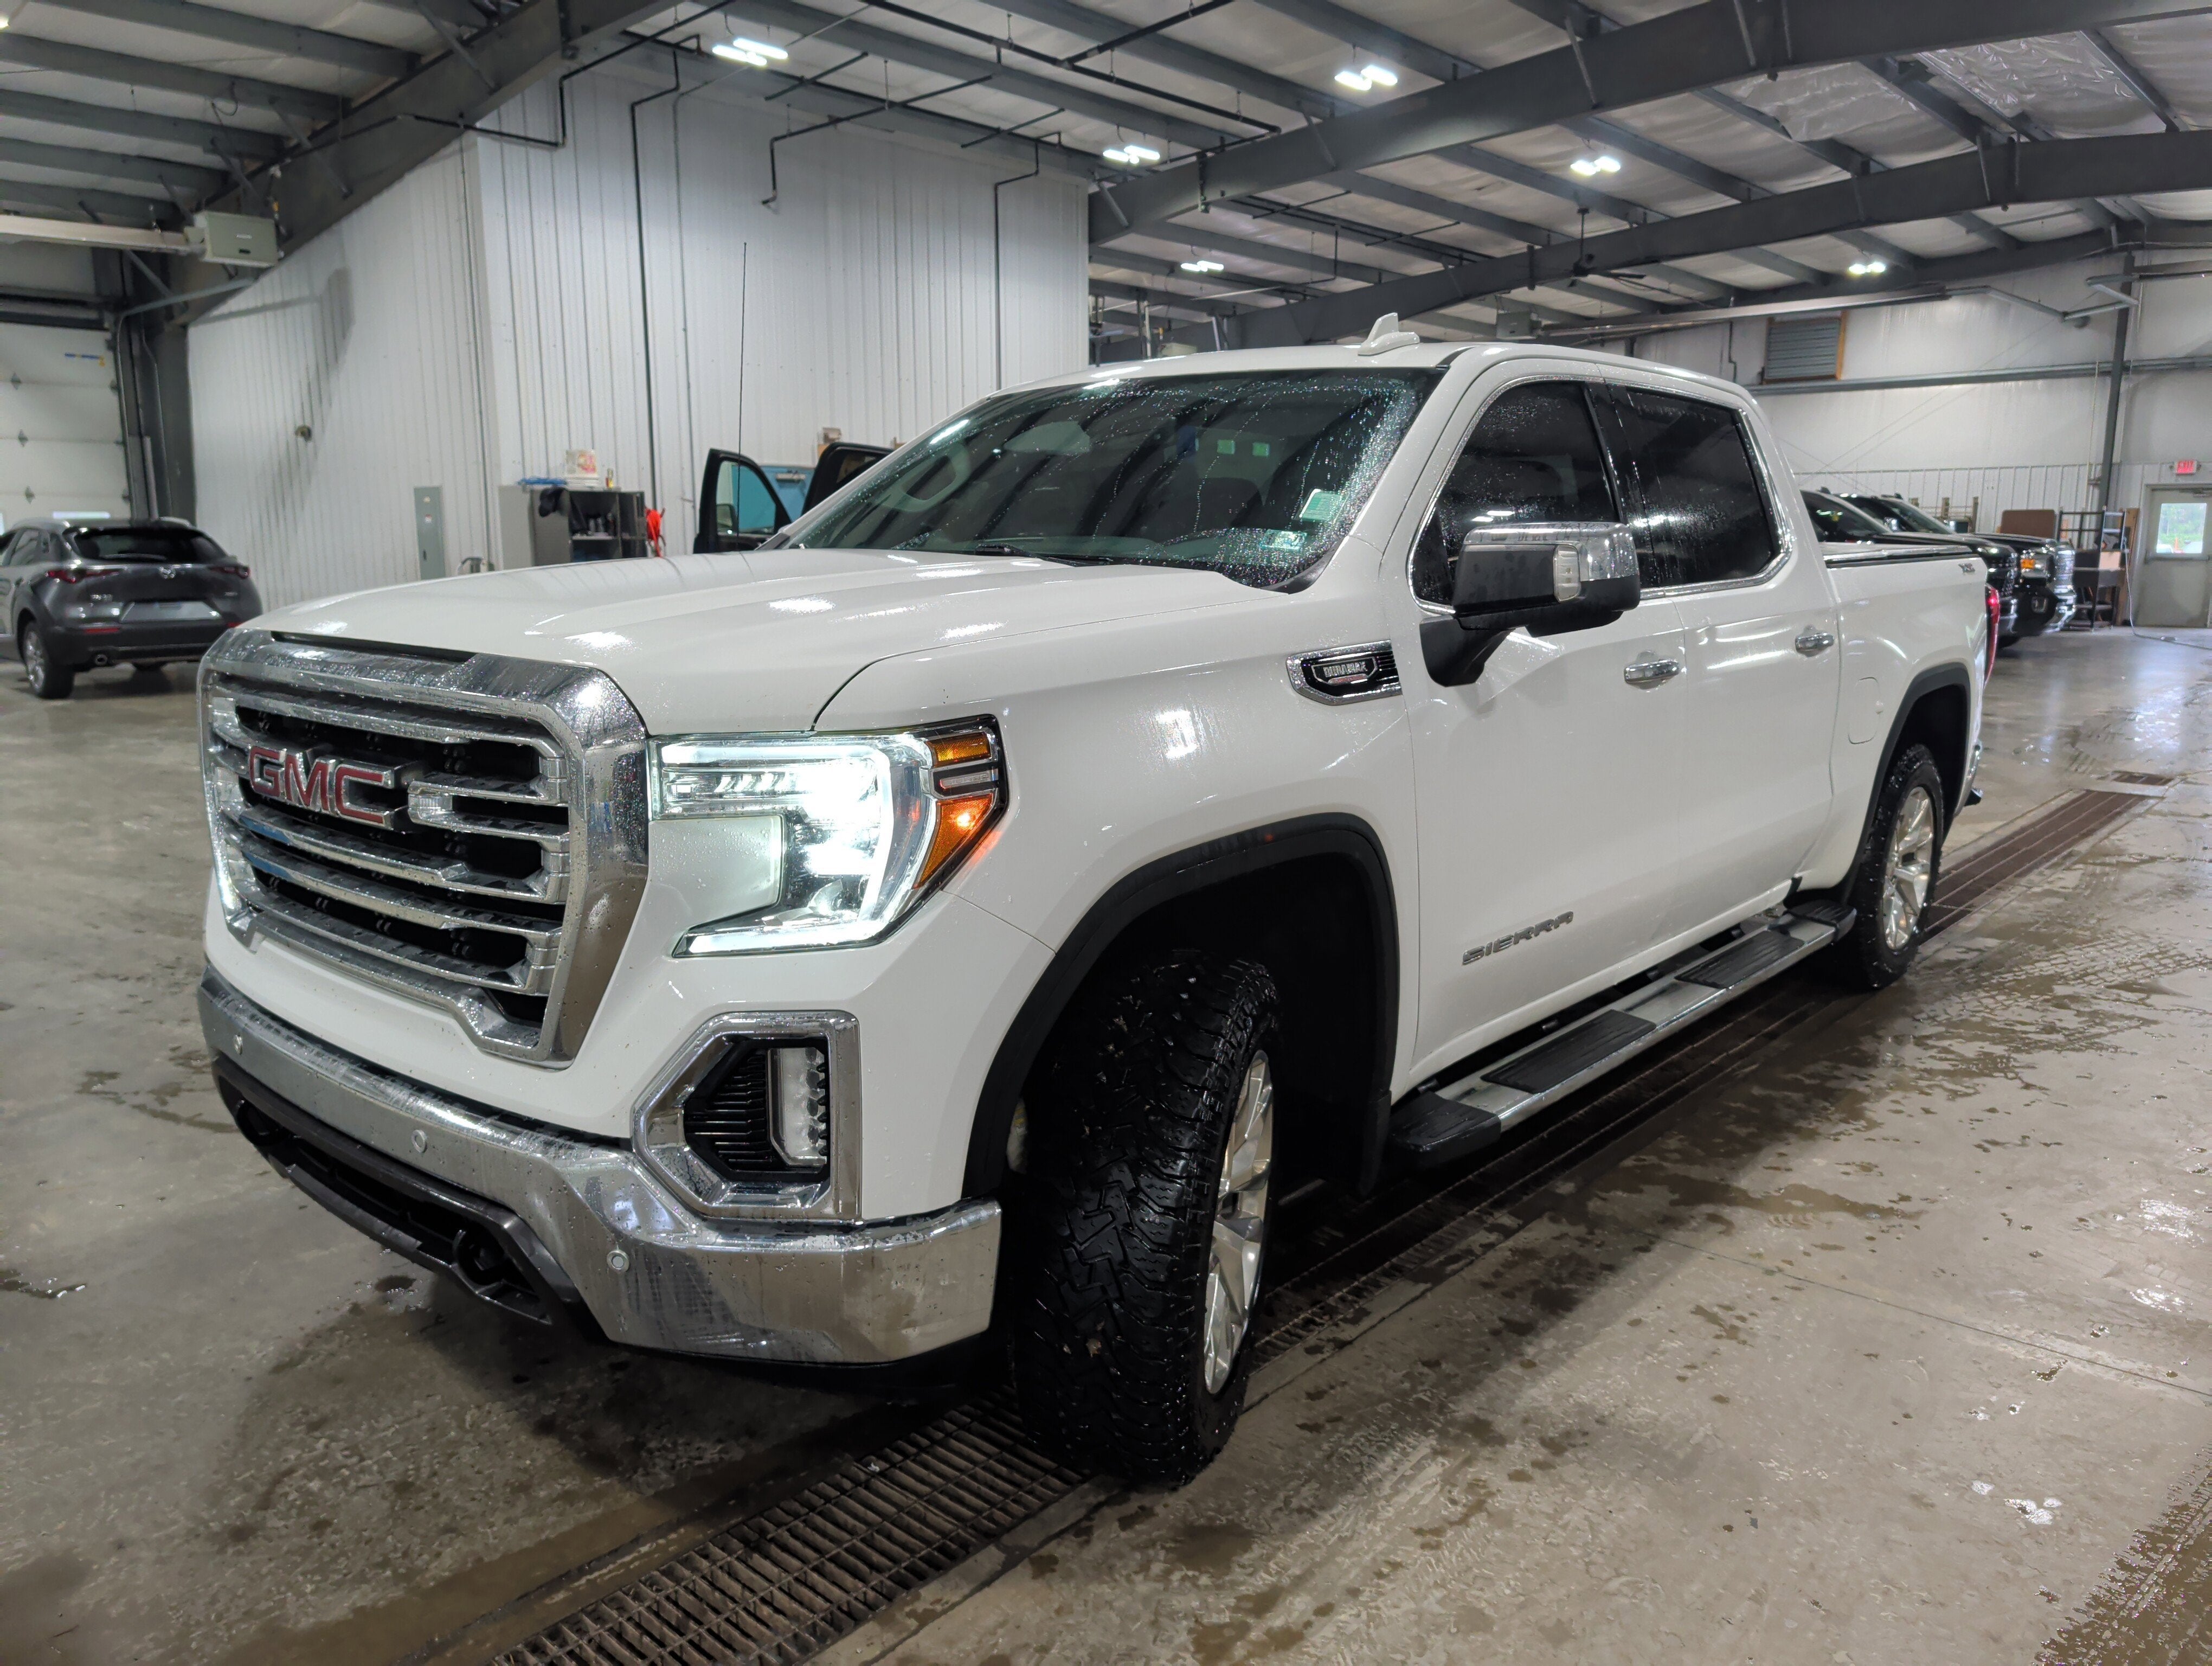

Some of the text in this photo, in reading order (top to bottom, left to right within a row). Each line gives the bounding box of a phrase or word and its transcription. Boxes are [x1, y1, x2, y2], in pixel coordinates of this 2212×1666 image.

[1323, 661, 1368, 678] DURAMAX
[249, 746, 393, 829] GMC
[1462, 911, 1574, 965] SIERRA
